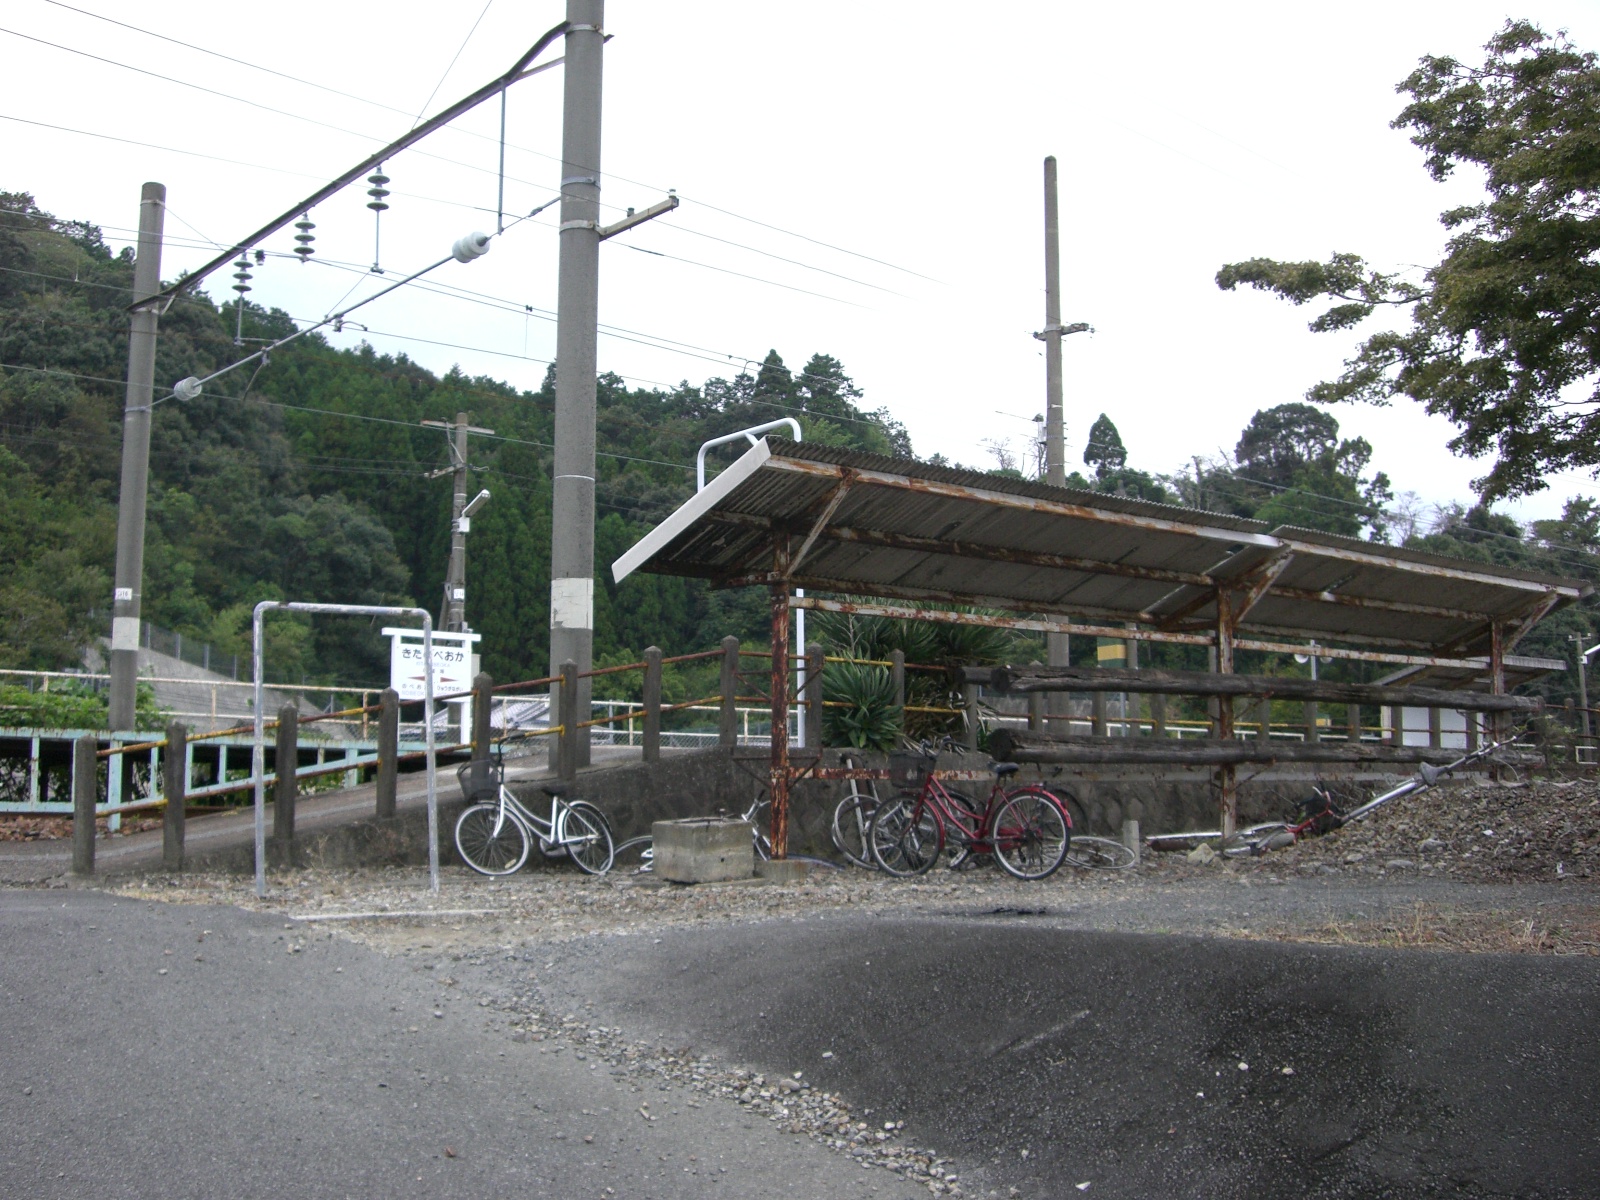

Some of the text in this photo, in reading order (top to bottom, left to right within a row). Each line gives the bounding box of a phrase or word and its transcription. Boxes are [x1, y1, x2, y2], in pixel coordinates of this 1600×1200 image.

[402, 648, 464, 662] きたべおか
